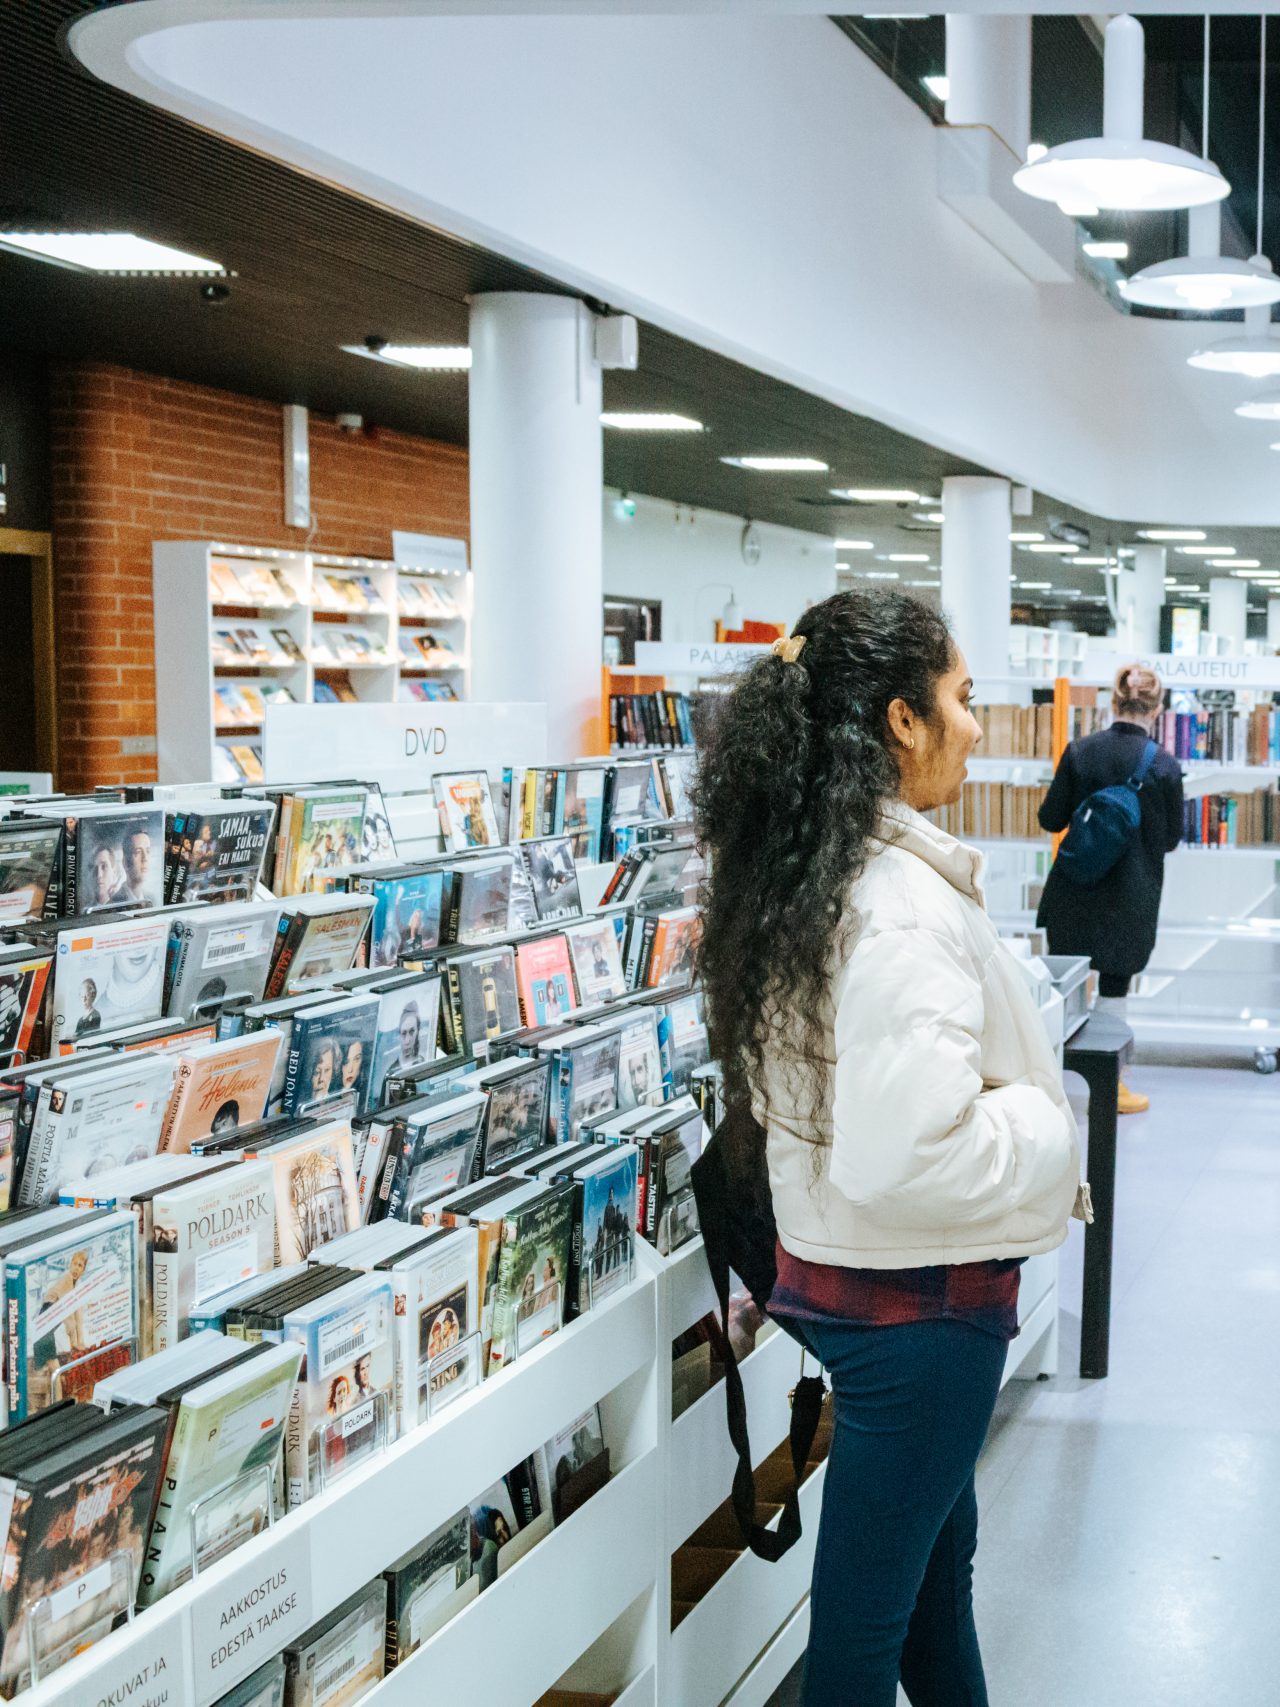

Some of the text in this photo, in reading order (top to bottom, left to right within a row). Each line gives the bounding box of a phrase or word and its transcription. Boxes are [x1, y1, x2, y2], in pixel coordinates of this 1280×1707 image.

[405, 728, 447, 756] DVD
[284, 1049, 300, 1108] RED JOAN
[40, 1123, 57, 1164] POSTIA
[187, 1192, 269, 1250] POLDARK
[208, 1229, 243, 1250] SEASON
[154, 1263, 168, 1329] POLDARK
[430, 1362, 459, 1392] STING
[344, 1407, 372, 1430] POLDARK
[143, 1476, 178, 1587] PIANO
[77, 1580, 87, 1600] P
[219, 1567, 288, 1631] AAKKOSTUS
[210, 1592, 298, 1670] EDESTÄ TAAKSE
[152, 1656, 167, 1678] JA
